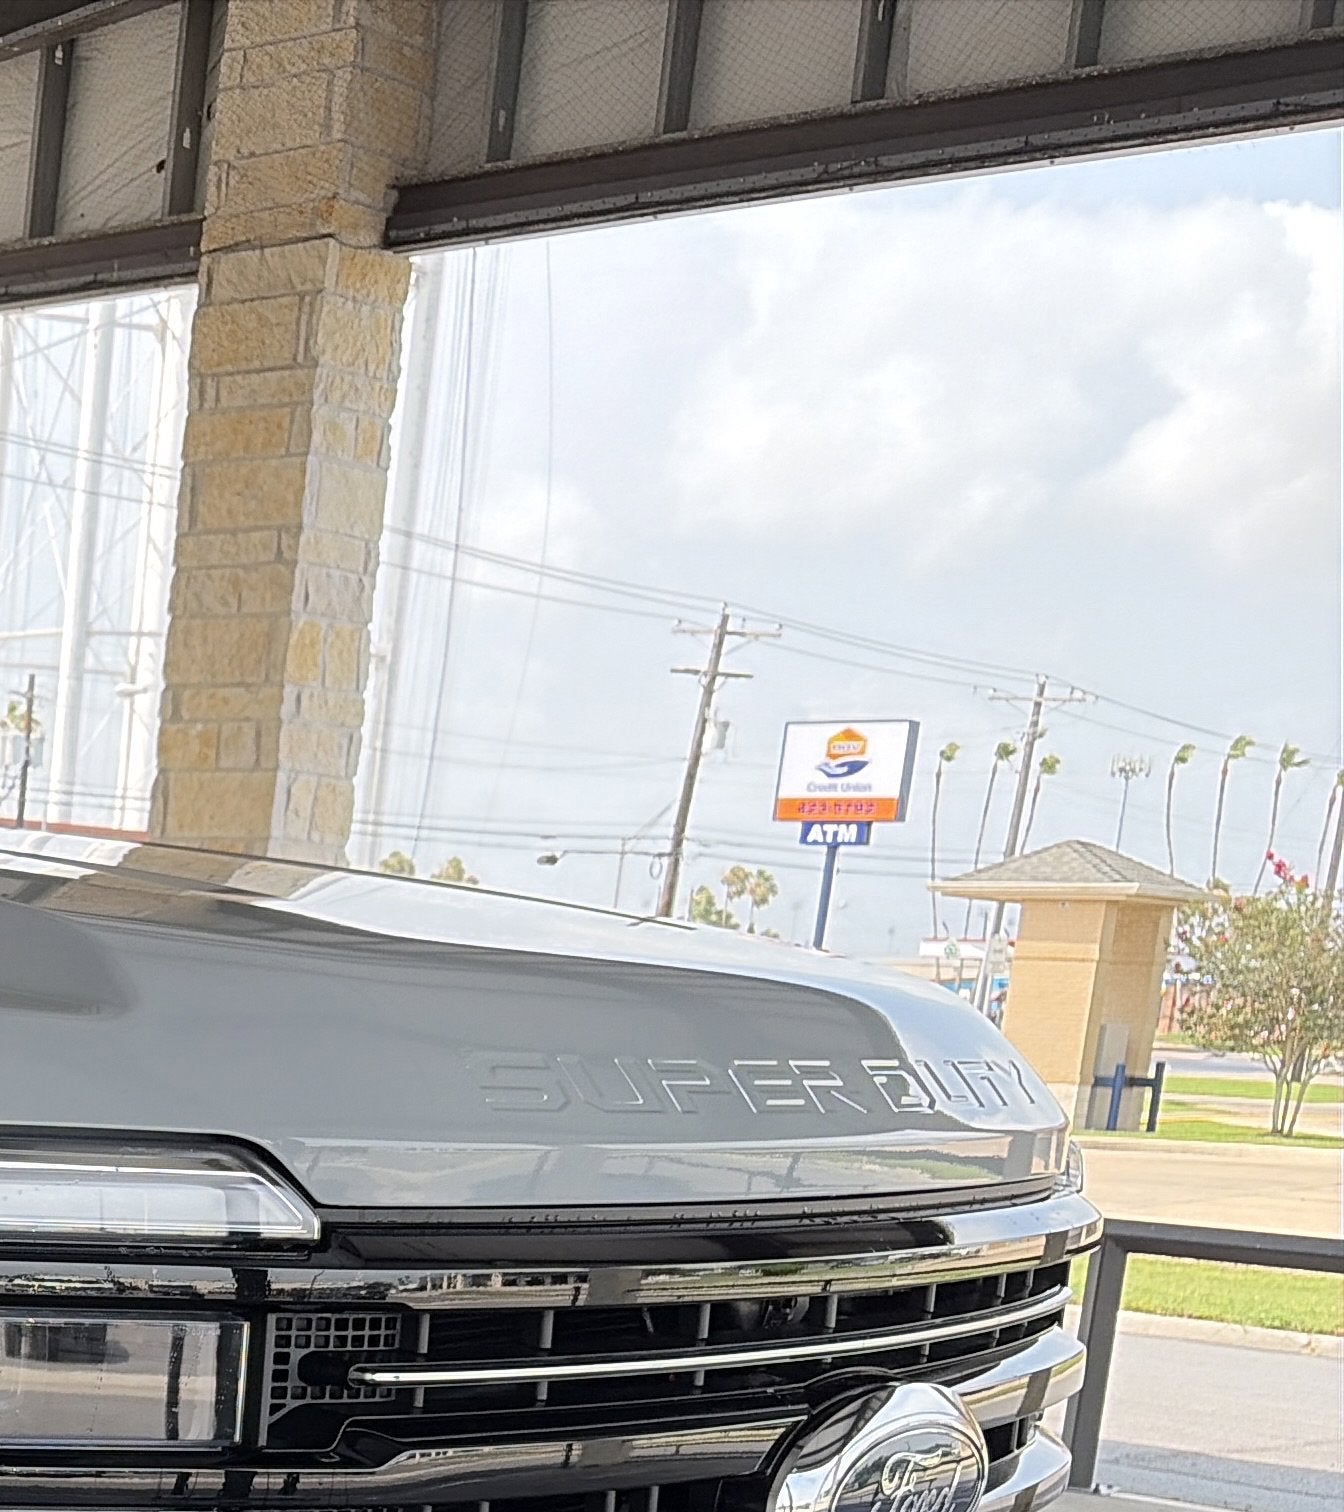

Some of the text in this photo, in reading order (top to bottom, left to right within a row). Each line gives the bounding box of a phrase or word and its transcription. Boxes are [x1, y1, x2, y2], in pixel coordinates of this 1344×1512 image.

[807, 823, 858, 843] ATM
[478, 1053, 1036, 1115] SUPER DUTY
